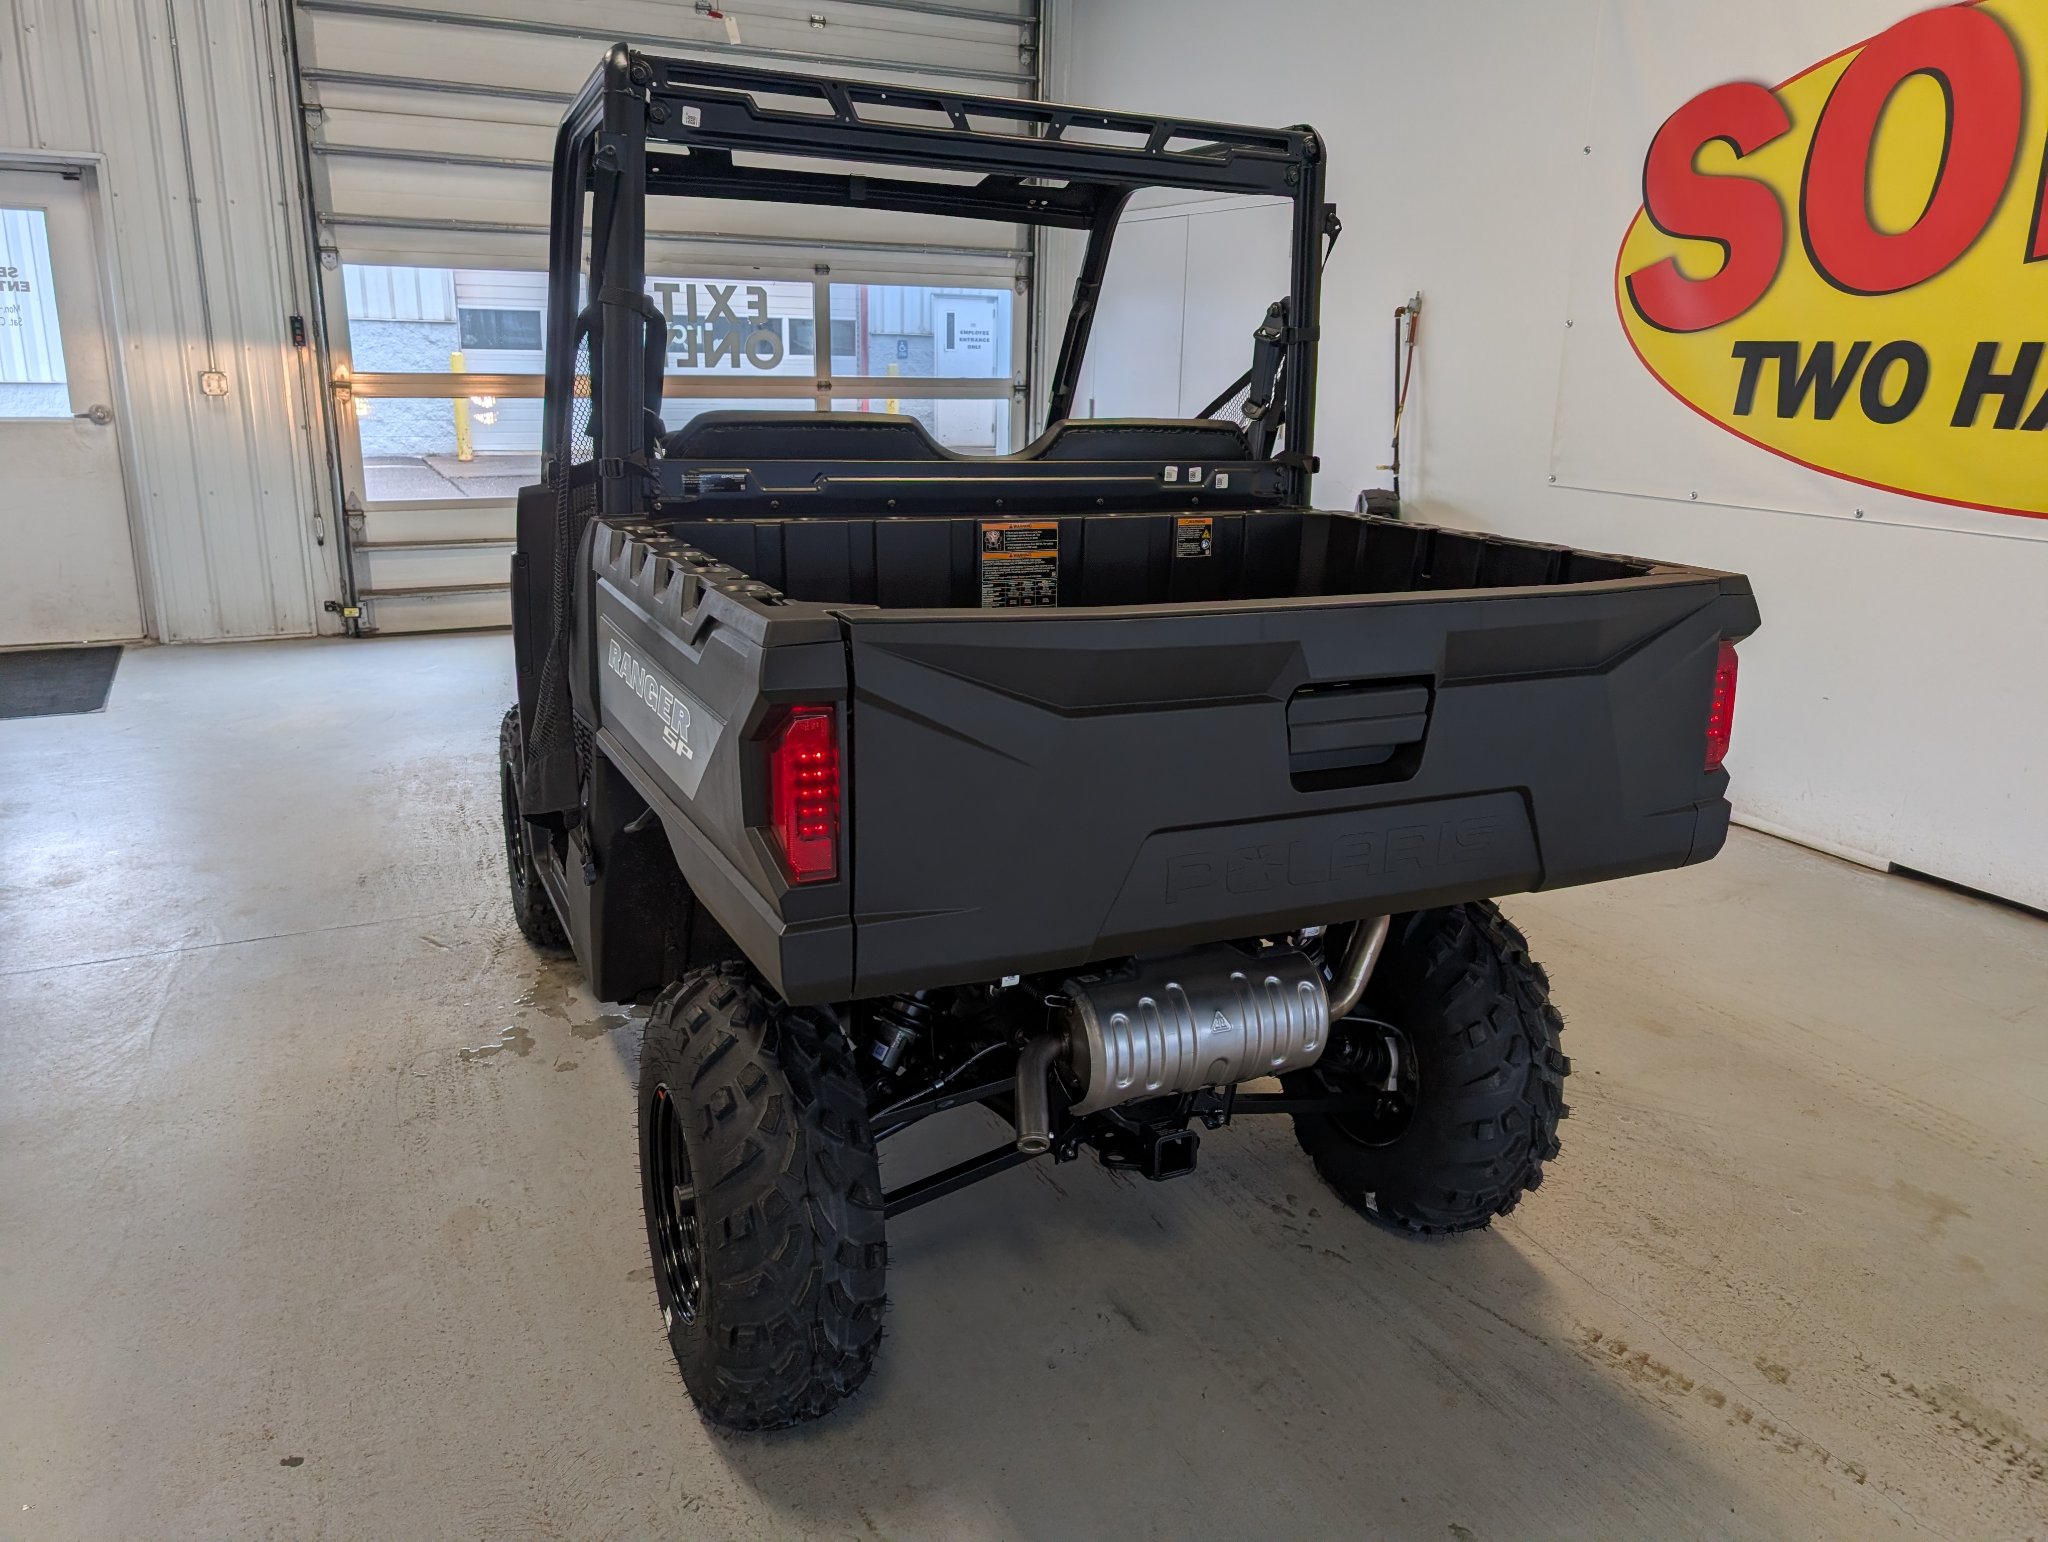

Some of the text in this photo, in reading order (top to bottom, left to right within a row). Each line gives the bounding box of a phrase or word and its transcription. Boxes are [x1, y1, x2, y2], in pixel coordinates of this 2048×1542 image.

[1625, 5, 2048, 334] SO
[1730, 341, 1930, 425] TWO
[607, 638, 691, 743] RANGER
[662, 726, 694, 760] SP
[1164, 815, 1497, 905] POLARIS
